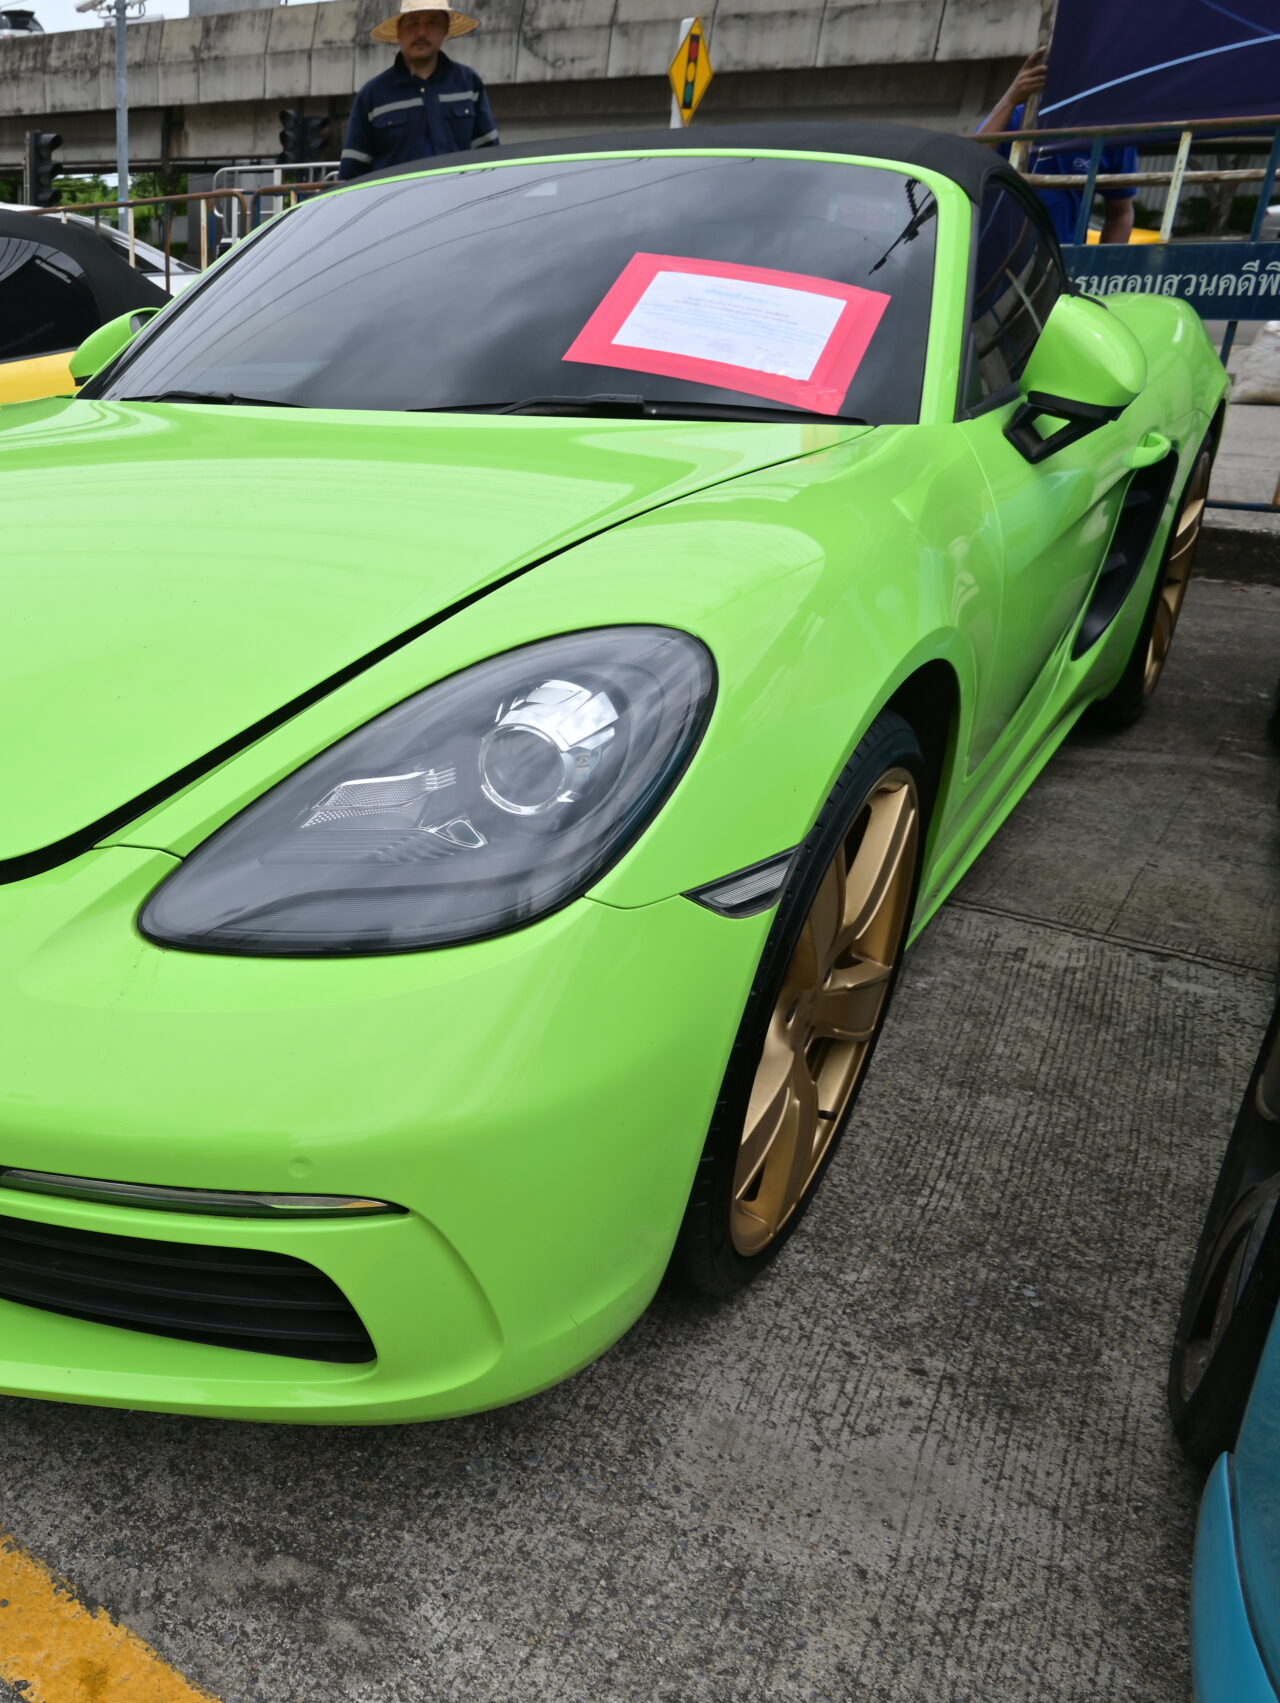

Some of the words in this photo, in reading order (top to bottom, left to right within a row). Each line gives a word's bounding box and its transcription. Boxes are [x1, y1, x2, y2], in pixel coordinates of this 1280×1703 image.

[1069, 259, 1280, 297] รมสอบสวนคดีพิ
